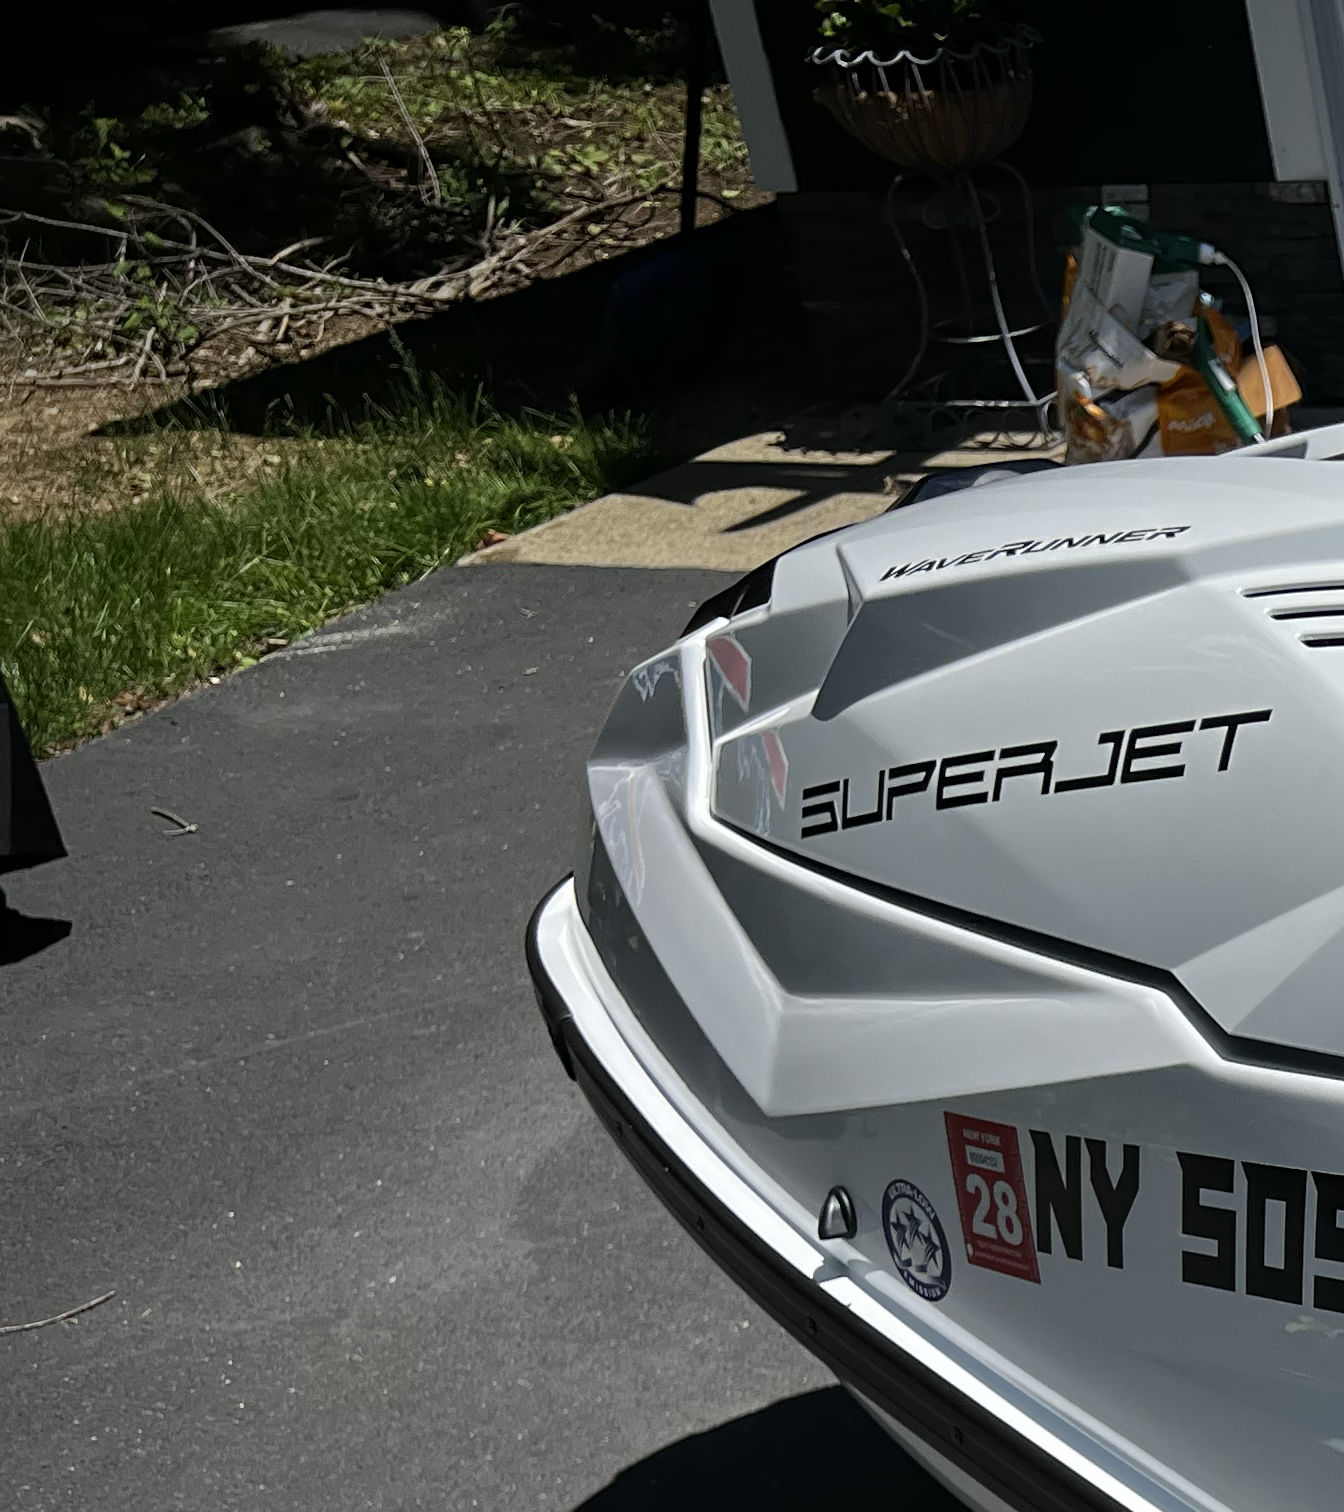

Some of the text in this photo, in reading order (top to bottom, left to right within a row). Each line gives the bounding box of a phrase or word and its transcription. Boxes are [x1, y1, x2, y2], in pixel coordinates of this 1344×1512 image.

[800, 708, 1273, 839] SUPERJET
[965, 1172, 1024, 1247] 28
[1028, 1129, 1141, 1270] NY
